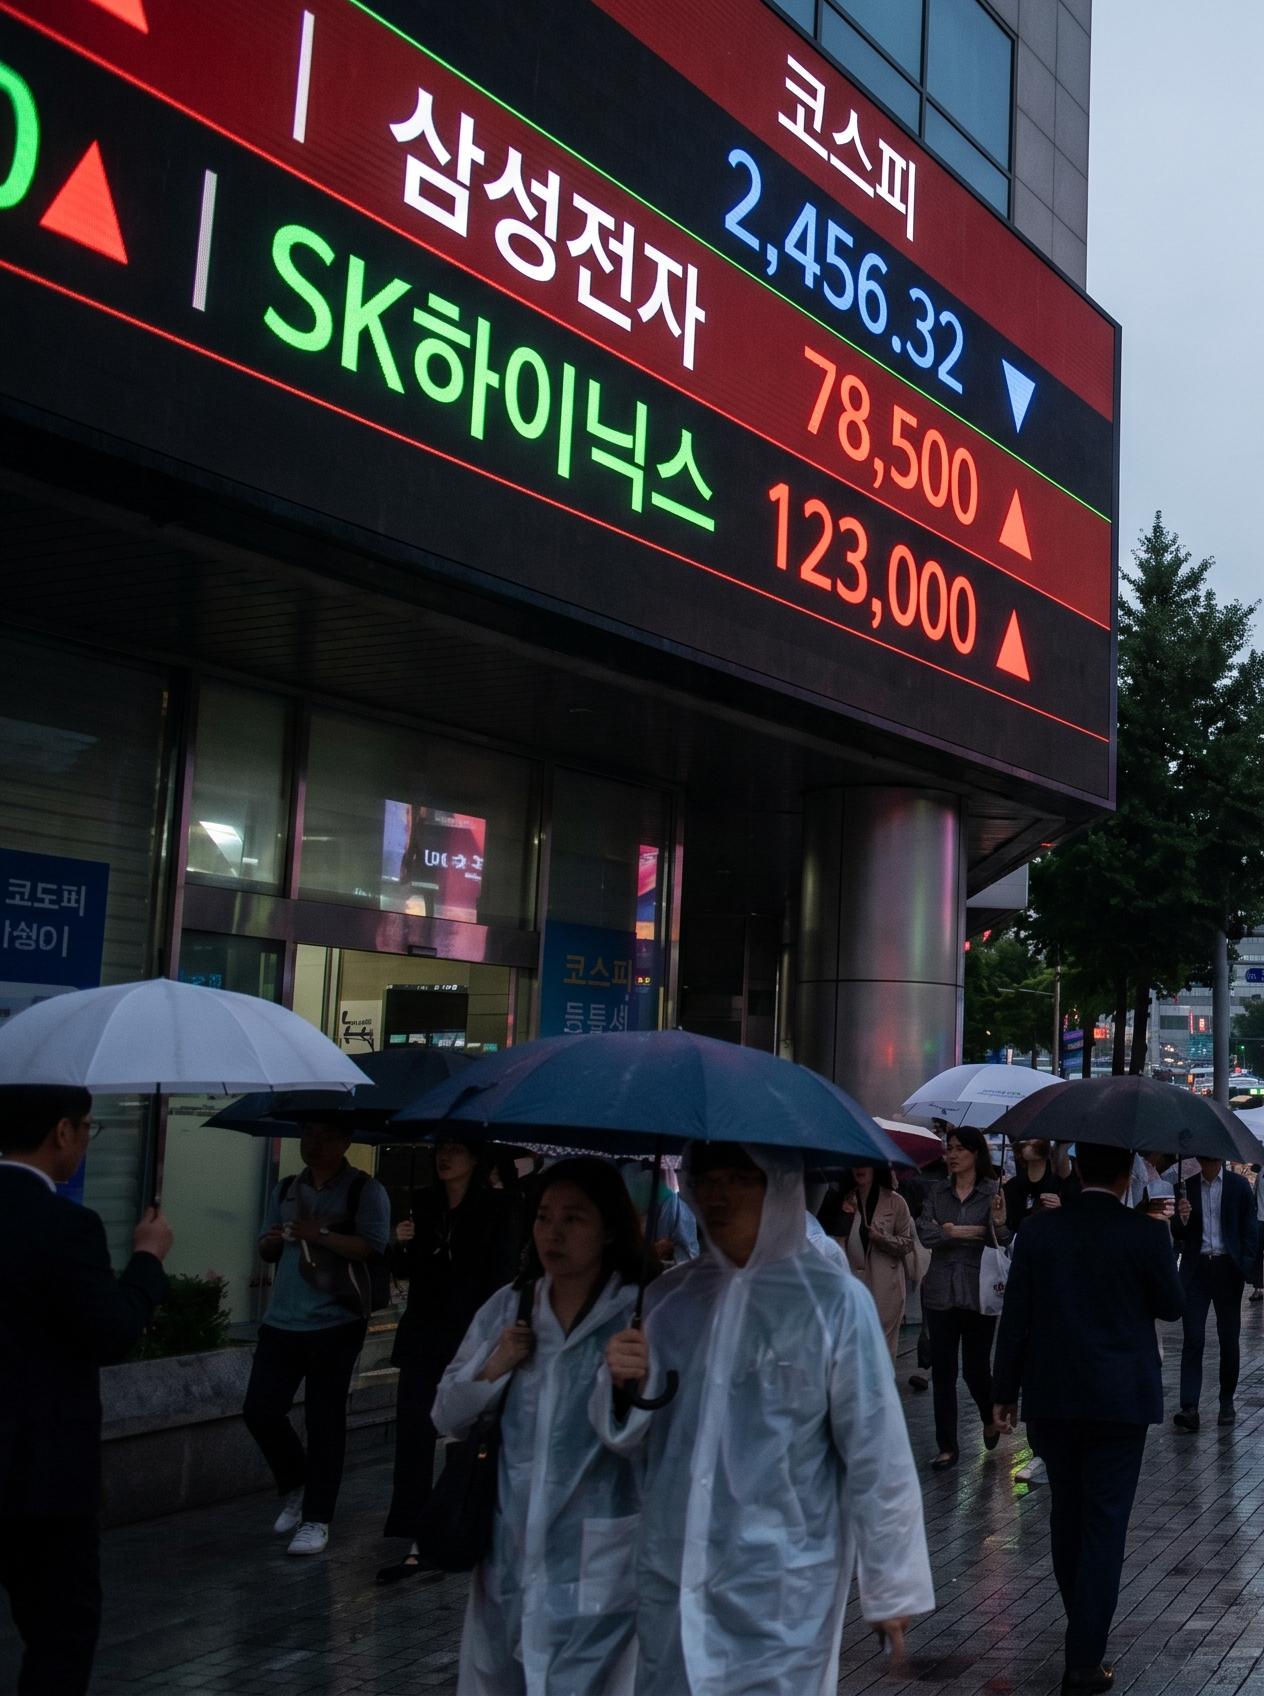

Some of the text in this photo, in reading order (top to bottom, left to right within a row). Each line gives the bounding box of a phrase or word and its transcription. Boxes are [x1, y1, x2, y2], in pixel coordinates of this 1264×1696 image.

[778, 54, 916, 241] 코스피
[389, 87, 978, 526] 삼성전자 78,500
[724, 148, 963, 394] 2,456.32
[264, 224, 714, 532] SK하이닉스
[769, 482, 977, 655] 123,000
[563, 954, 632, 993] 코스피
